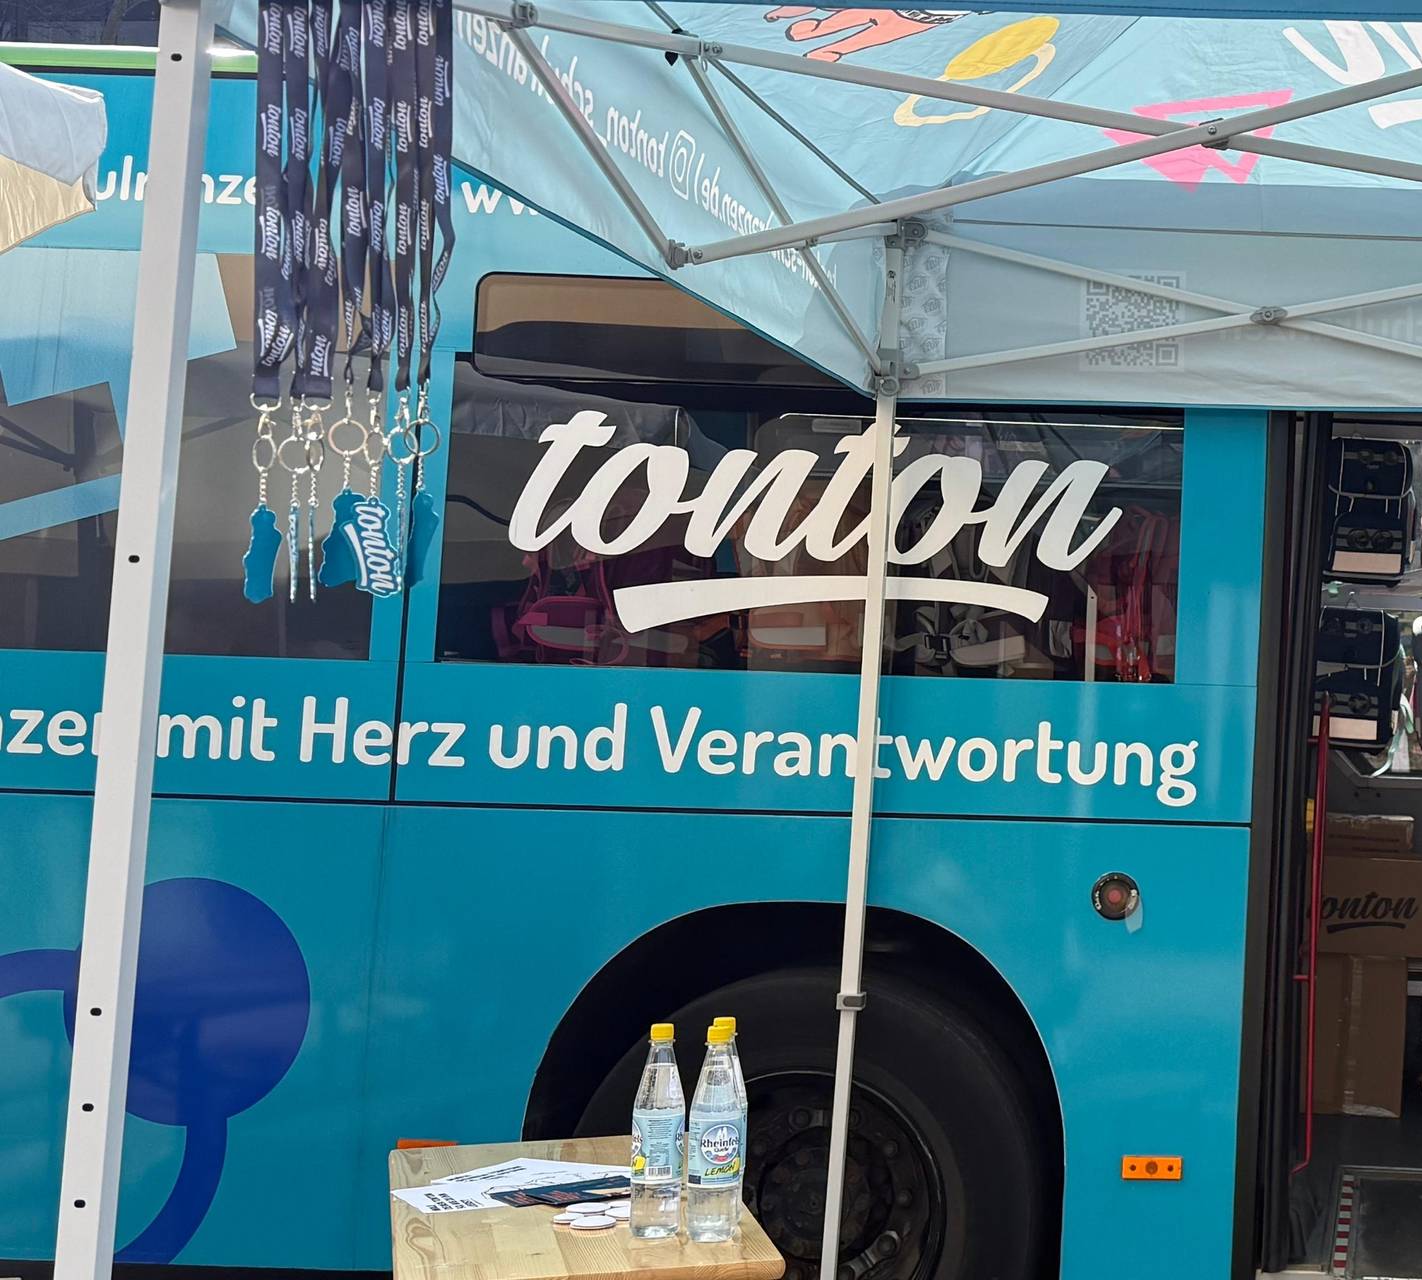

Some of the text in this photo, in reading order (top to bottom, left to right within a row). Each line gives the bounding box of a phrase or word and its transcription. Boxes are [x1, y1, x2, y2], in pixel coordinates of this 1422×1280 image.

[508, 410, 1123, 572] tonton
[355, 505, 395, 595] tonton
[156, 696, 279, 763] mit
[301, 696, 466, 769] Herz
[488, 703, 628, 772] und
[1307, 891, 1419, 920] onton
[705, 1161, 736, 1176] LEMON
